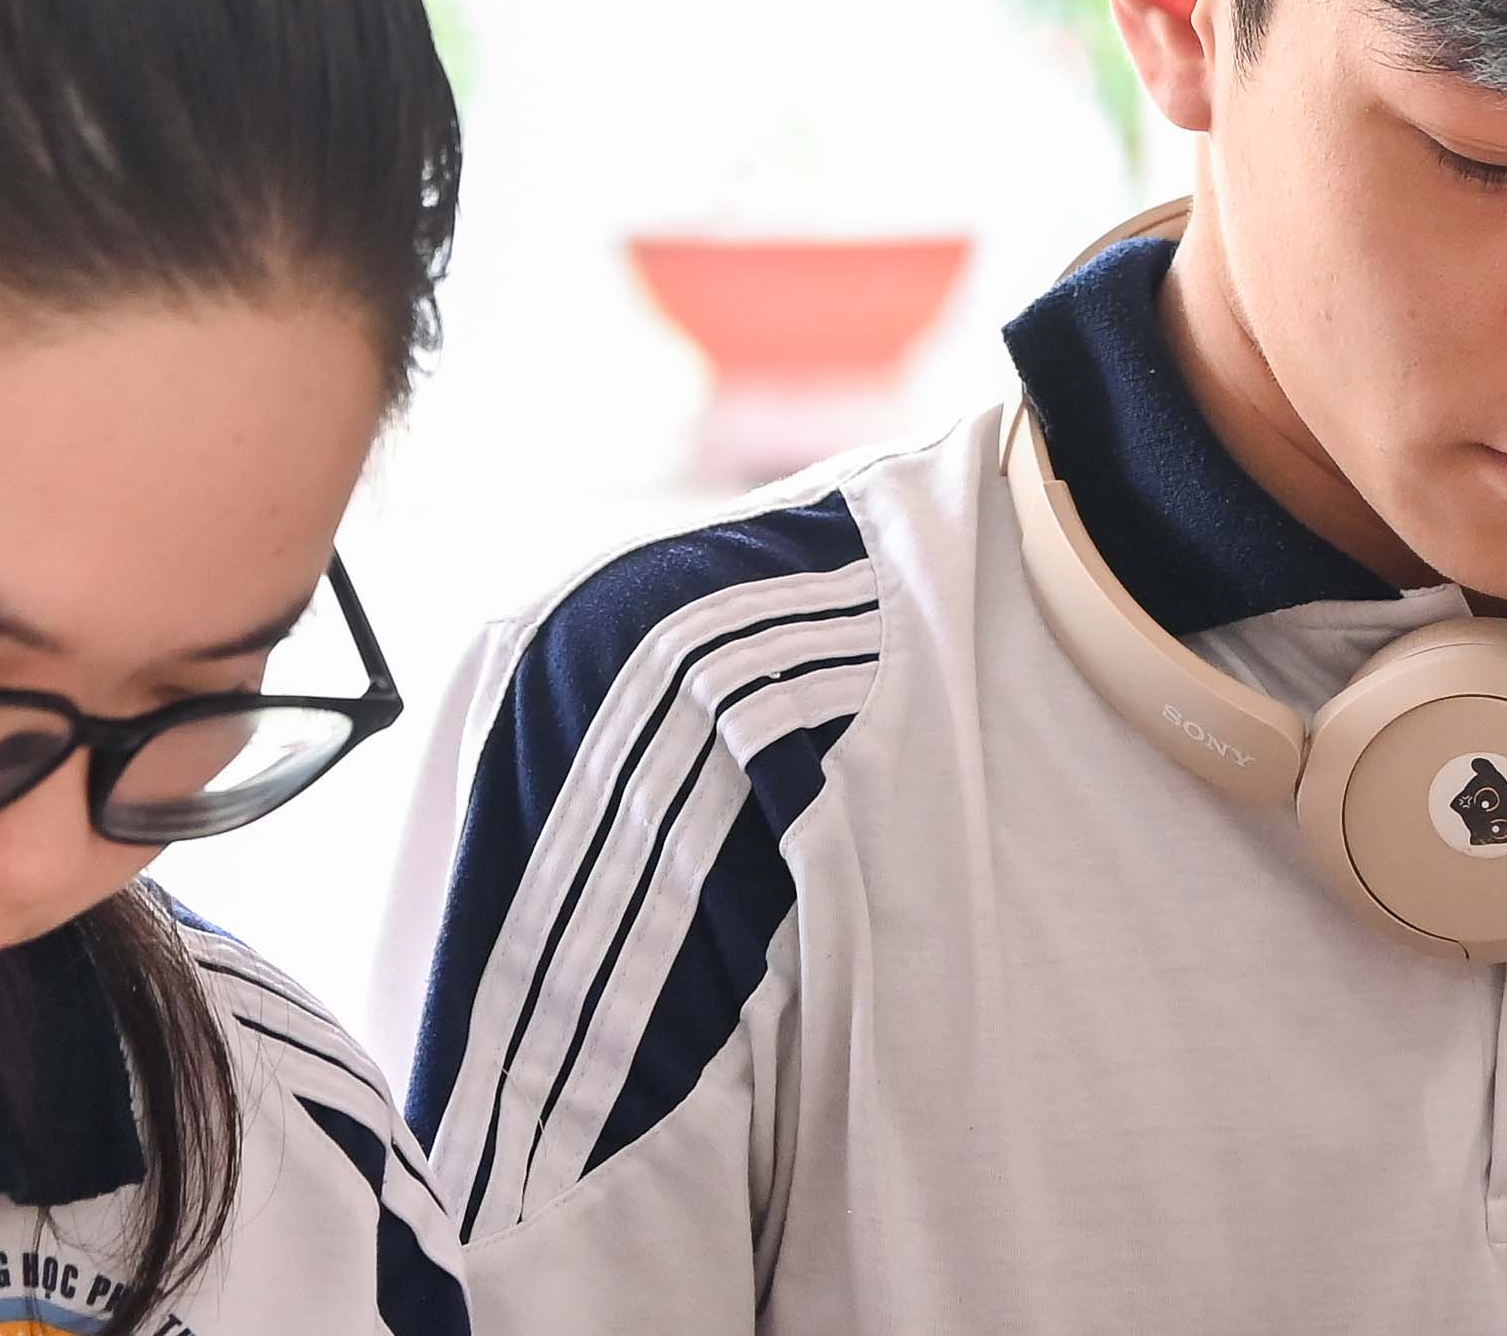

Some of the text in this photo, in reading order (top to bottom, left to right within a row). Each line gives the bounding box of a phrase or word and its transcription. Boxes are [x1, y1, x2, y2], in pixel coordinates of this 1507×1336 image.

[1162, 703, 1256, 769] SONY
[23, 1253, 78, 1299] HỌC
[87, 1274, 133, 1313] PH
